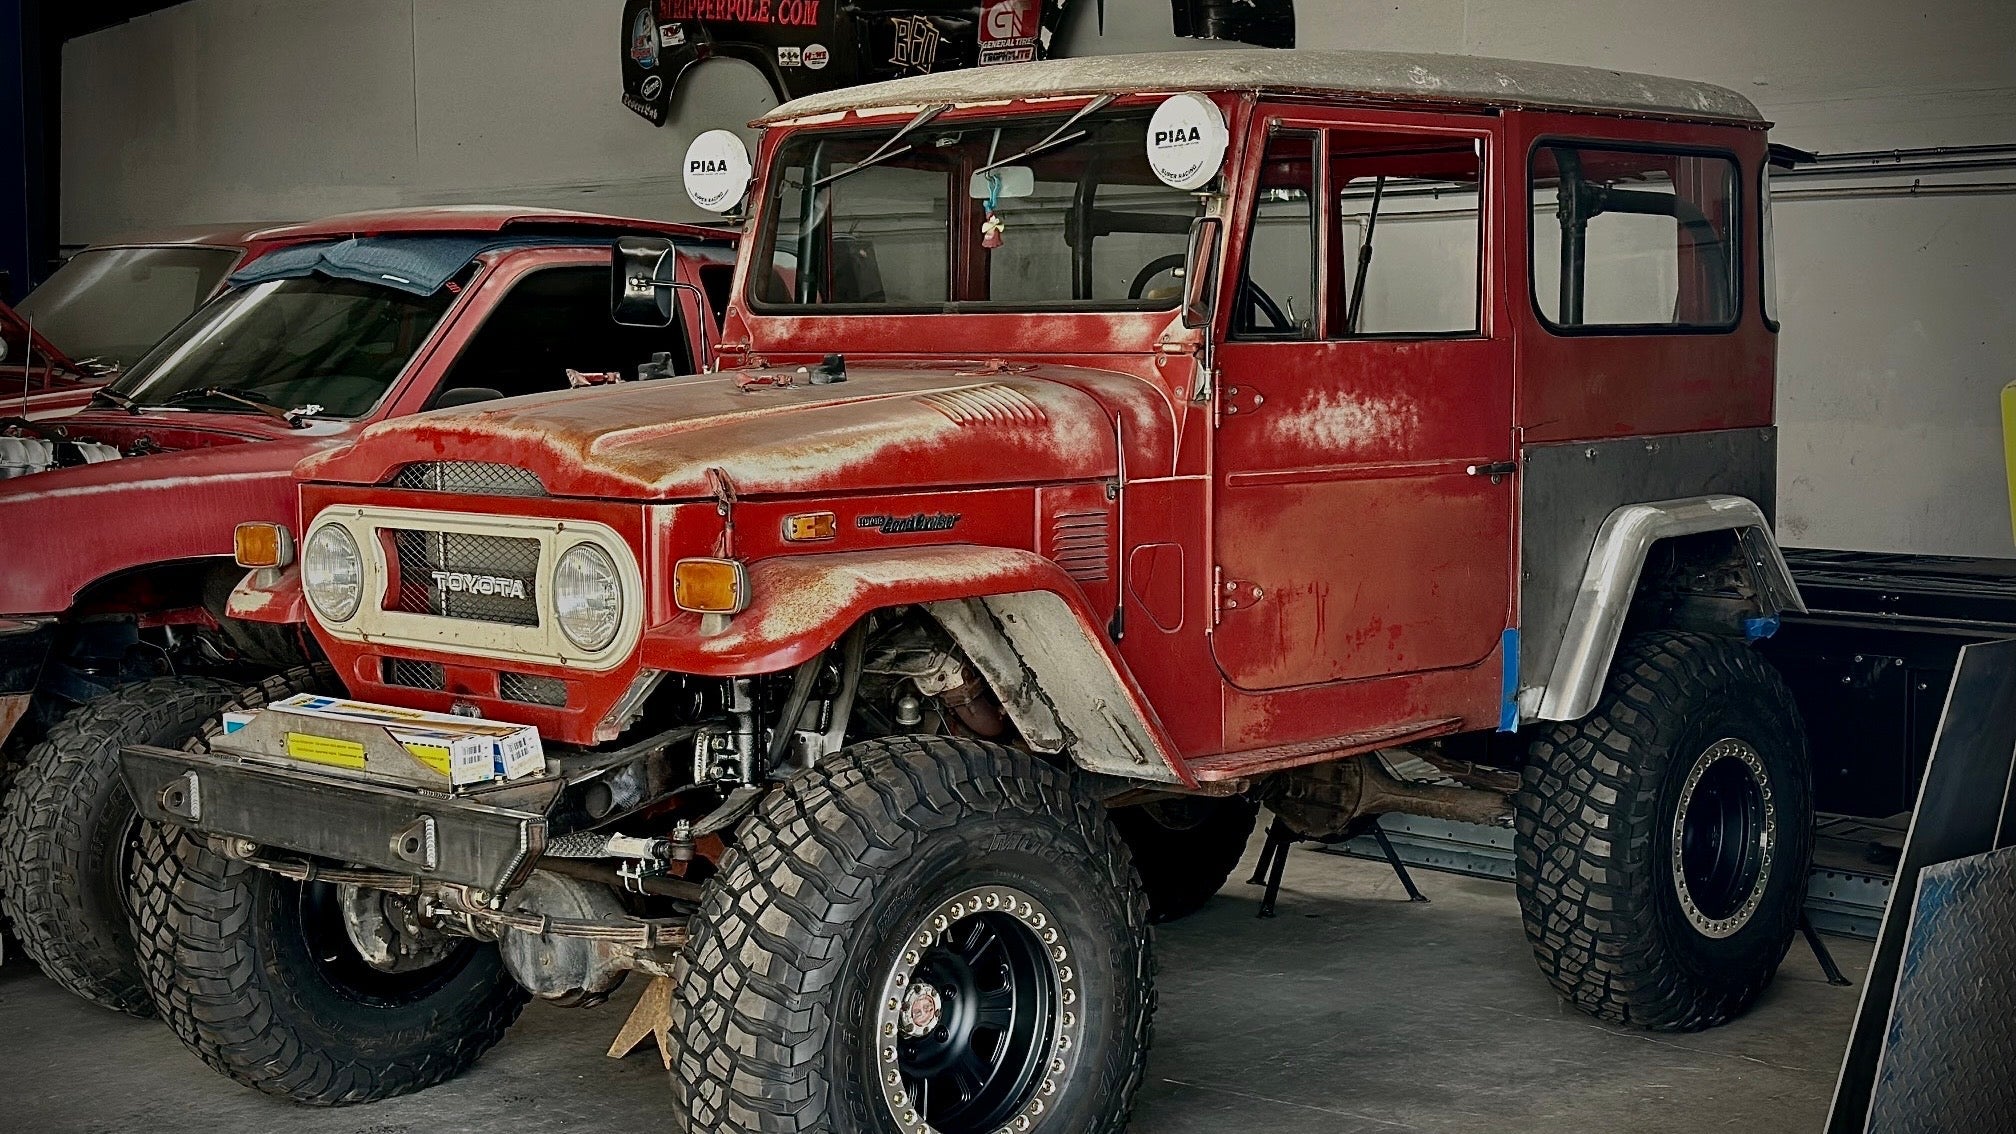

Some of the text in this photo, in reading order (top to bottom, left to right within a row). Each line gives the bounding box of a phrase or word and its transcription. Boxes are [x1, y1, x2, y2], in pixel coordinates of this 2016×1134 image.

[982, 38, 1032, 49] GENERAL TIRE
[1155, 127, 1200, 145] PIAA
[690, 160, 727, 172] PIAA
[1161, 164, 1197, 179] SUPER RACING
[431, 570, 526, 600] TOYOTA
